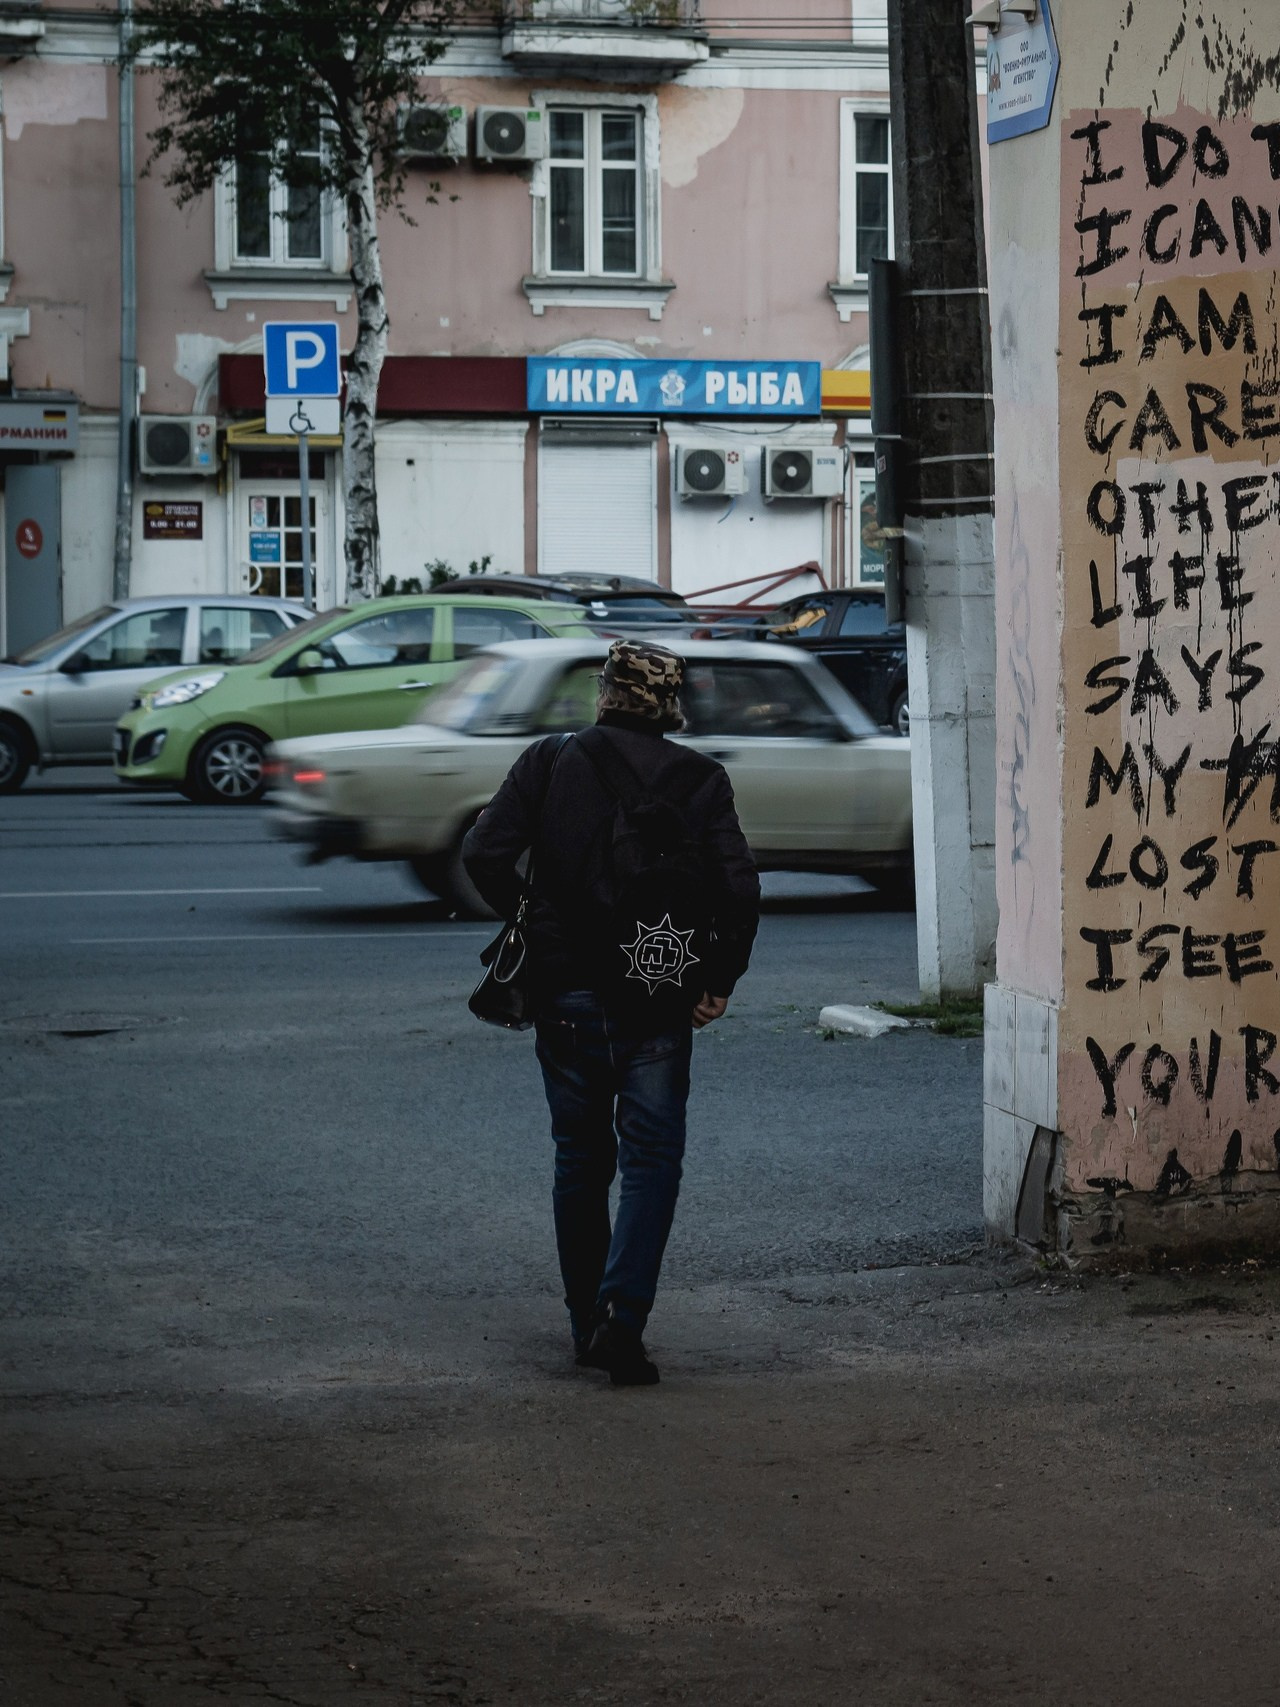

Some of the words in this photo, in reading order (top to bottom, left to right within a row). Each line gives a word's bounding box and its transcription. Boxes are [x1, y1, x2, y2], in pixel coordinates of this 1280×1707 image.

[1071, 120, 1124, 186] I
[1142, 118, 1230, 187] DO
[286, 331, 326, 389] P
[1078, 303, 1127, 367] I
[1141, 287, 1257, 360] AM
[546, 368, 638, 403] ИКРА
[706, 371, 804, 406] РЫБА
[0, 427, 68, 440] РМАНИИ
[1090, 551, 1256, 628] LIFE
[1084, 642, 1265, 716] SAYS
[1085, 741, 1192, 818] MY
[1086, 834, 1280, 900] LOST
[1137, 924, 1274, 986] SEE
